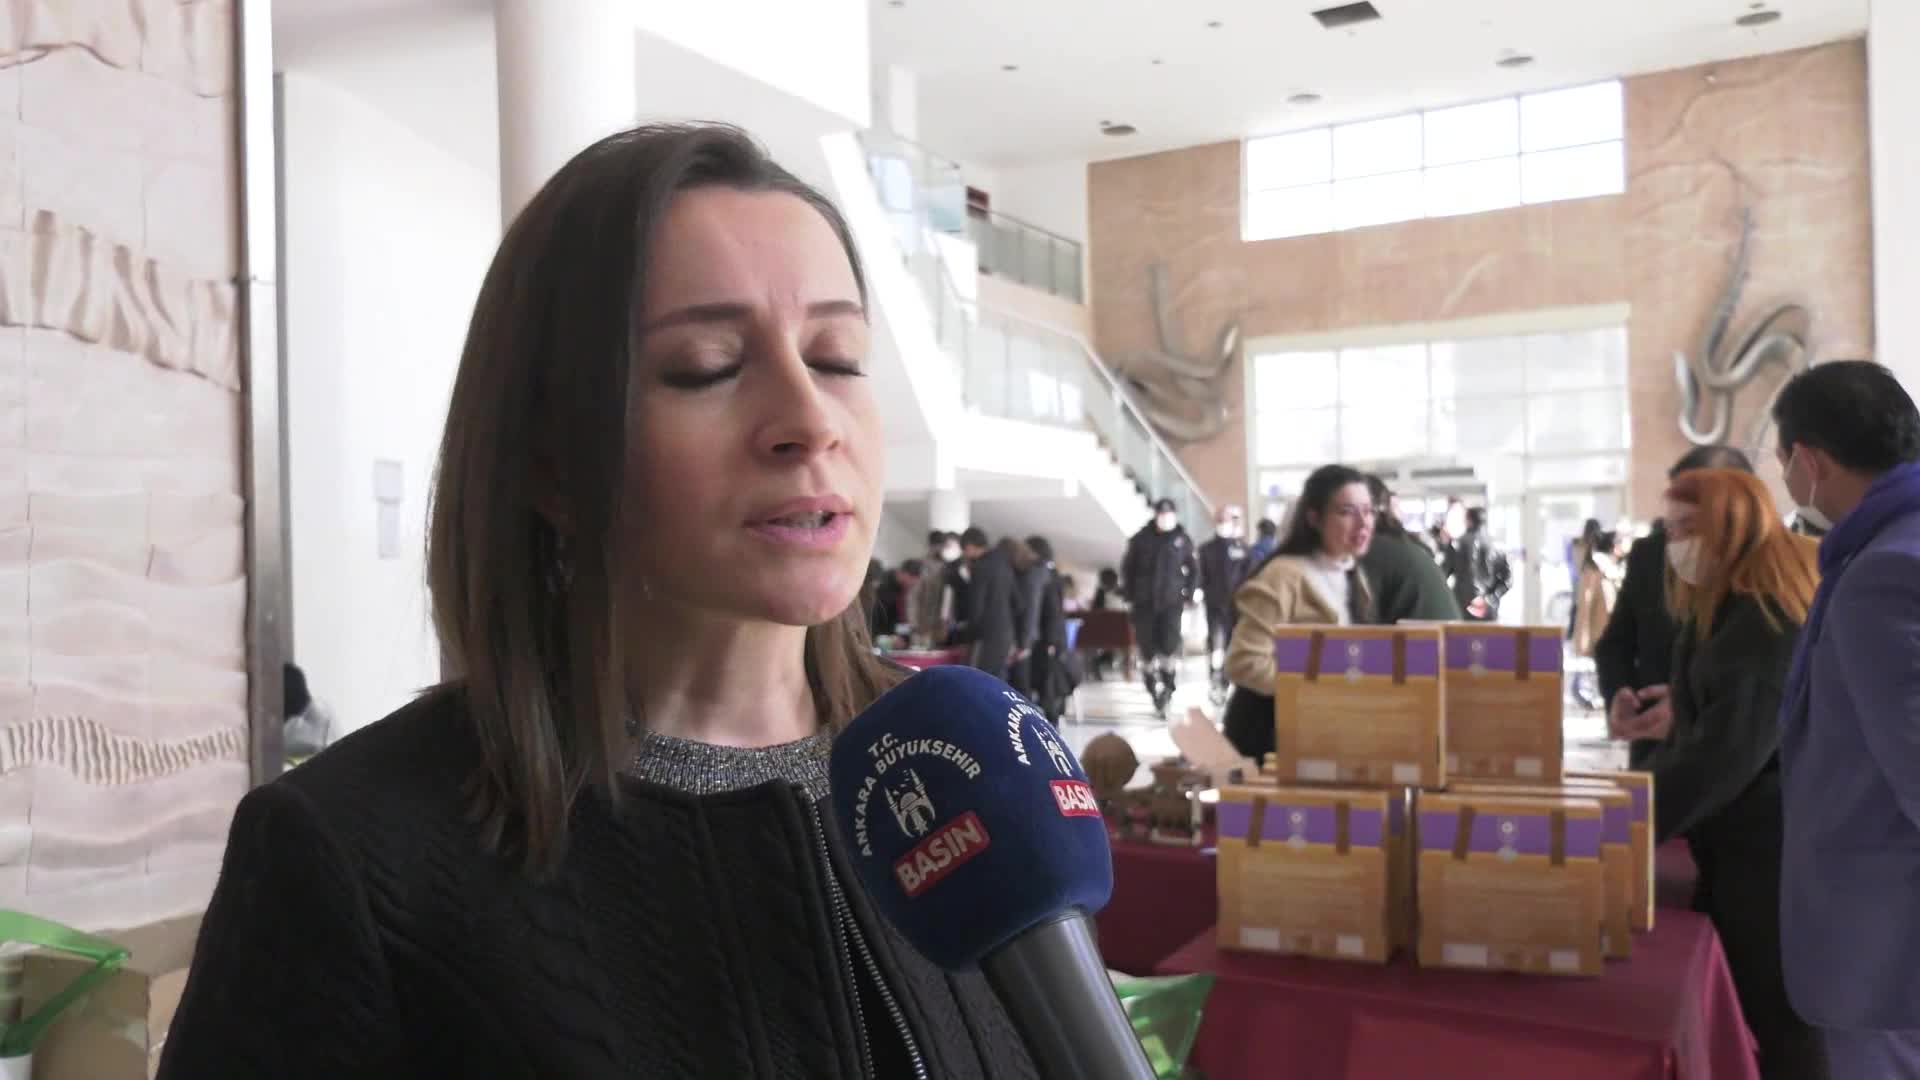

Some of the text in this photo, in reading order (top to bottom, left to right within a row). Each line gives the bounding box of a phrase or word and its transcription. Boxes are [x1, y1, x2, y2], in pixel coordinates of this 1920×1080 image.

[868, 732, 899, 757] T.C.
[1007, 707, 1031, 765] ANKARA
[855, 776, 877, 857] ANKARA
[896, 819, 982, 892] BASIN
